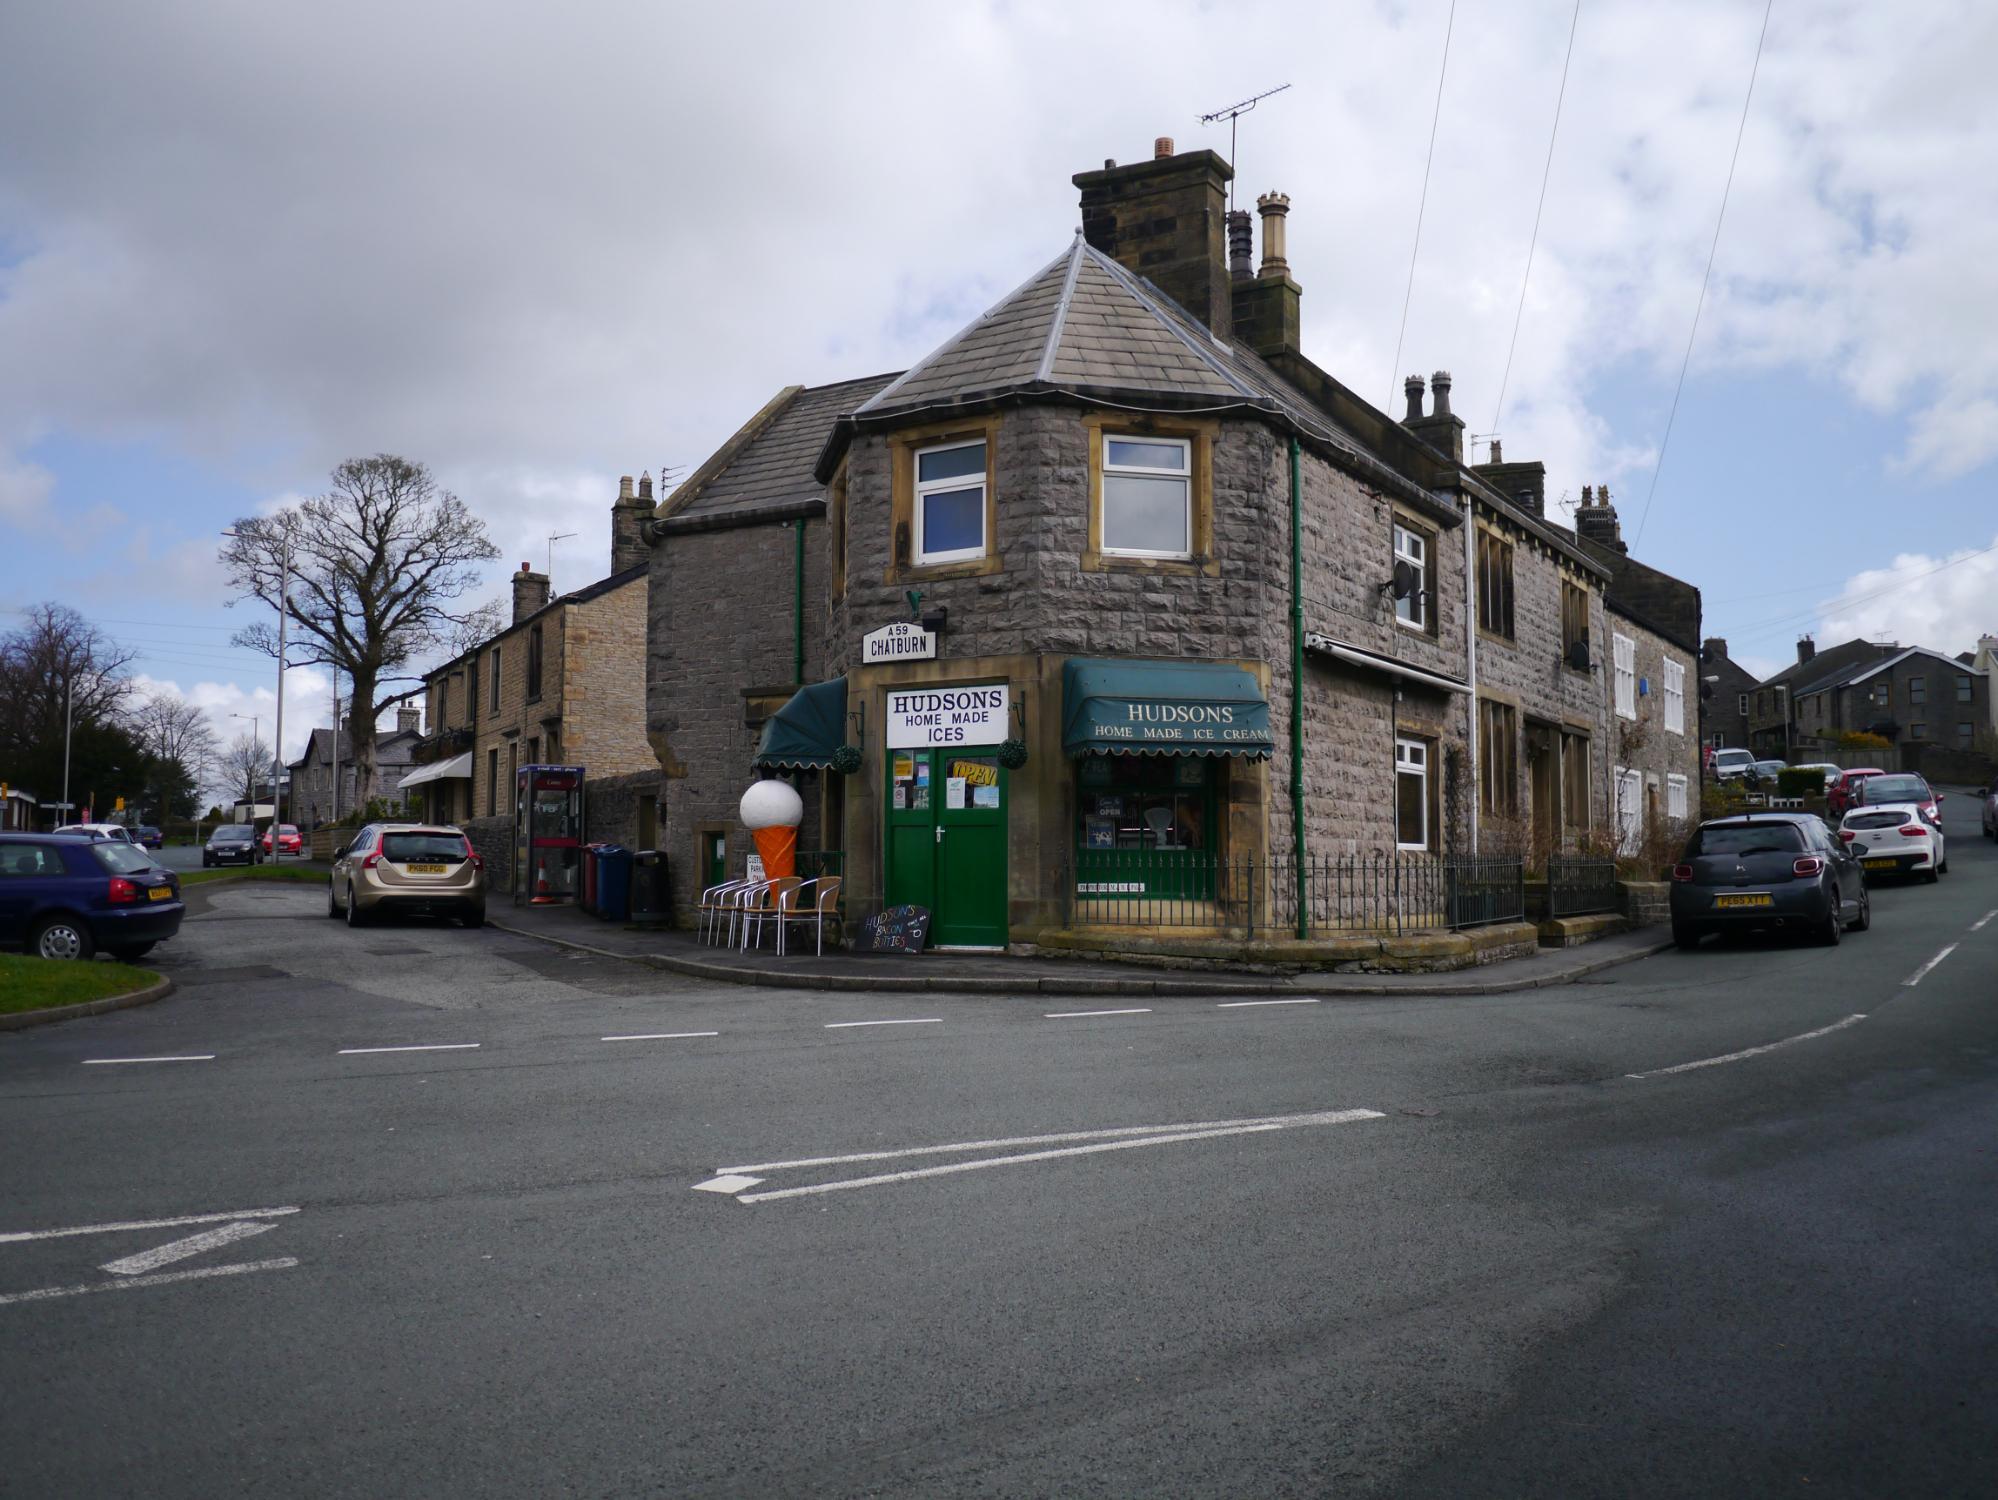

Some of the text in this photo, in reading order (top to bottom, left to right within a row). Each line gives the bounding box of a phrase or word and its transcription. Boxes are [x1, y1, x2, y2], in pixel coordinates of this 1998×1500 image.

[871, 636, 926, 656] CHATBURN
[893, 690, 1002, 713] HUDSONS
[905, 711, 989, 727] HOME MADE
[1128, 704, 1233, 723] HUDSONS
[928, 727, 964, 742] ICES
[1095, 725, 1270, 740] HOME MADE ICE CREAM
[953, 761, 998, 786] OPEN
[1099, 808, 1121, 816] OPEN
[875, 923, 903, 937] BACON
